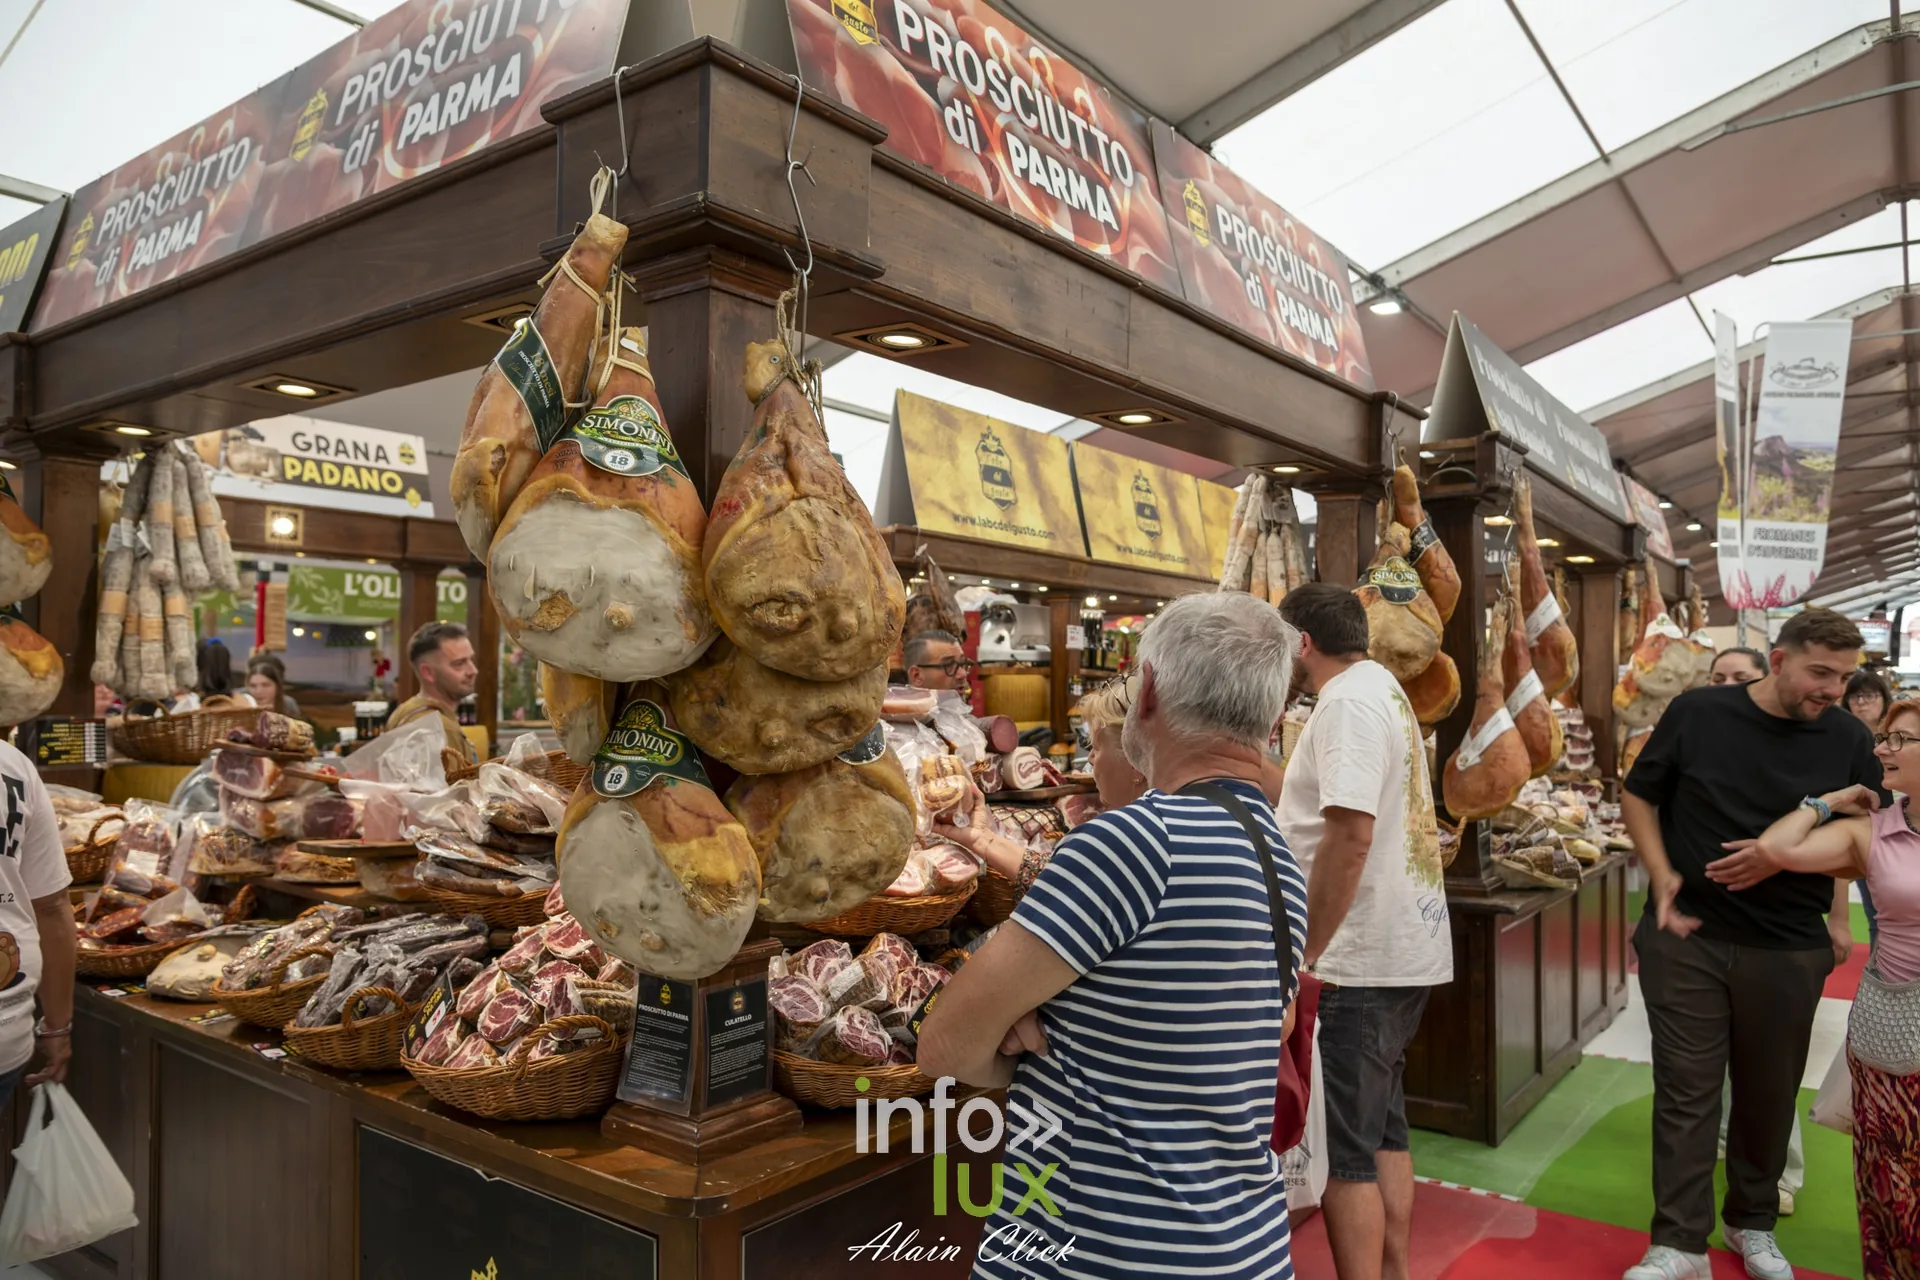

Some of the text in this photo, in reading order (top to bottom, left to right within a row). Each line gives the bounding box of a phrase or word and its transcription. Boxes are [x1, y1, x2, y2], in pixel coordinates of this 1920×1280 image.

[335, 0, 578, 126] PROSCIUTT
[343, 119, 379, 174] di
[396, 53, 521, 151] PARMA
[894, 0, 1134, 188] PROSCIUTTO
[96, 137, 250, 246] PROSCIUTTO
[944, 98, 981, 155] di
[1005, 132, 1119, 231] PARMA
[95, 247, 120, 287] di
[126, 210, 203, 274] PARMA
[1216, 204, 1343, 314] PROSCIUTTO
[1246, 272, 1338, 352] di PARMA
[291, 432, 391, 465] GRANA
[581, 414, 673, 454] SIMONINI
[609, 455, 629, 466] 18
[283, 456, 403, 494] PADANO
[604, 729, 677, 758] IMONINI
[608, 773, 622, 785] 18
[638, 1003, 667, 1016] PROSCIUTTO
[672, 1011, 689, 1022] PARMA
[724, 1013, 752, 1027] CULATELLO
